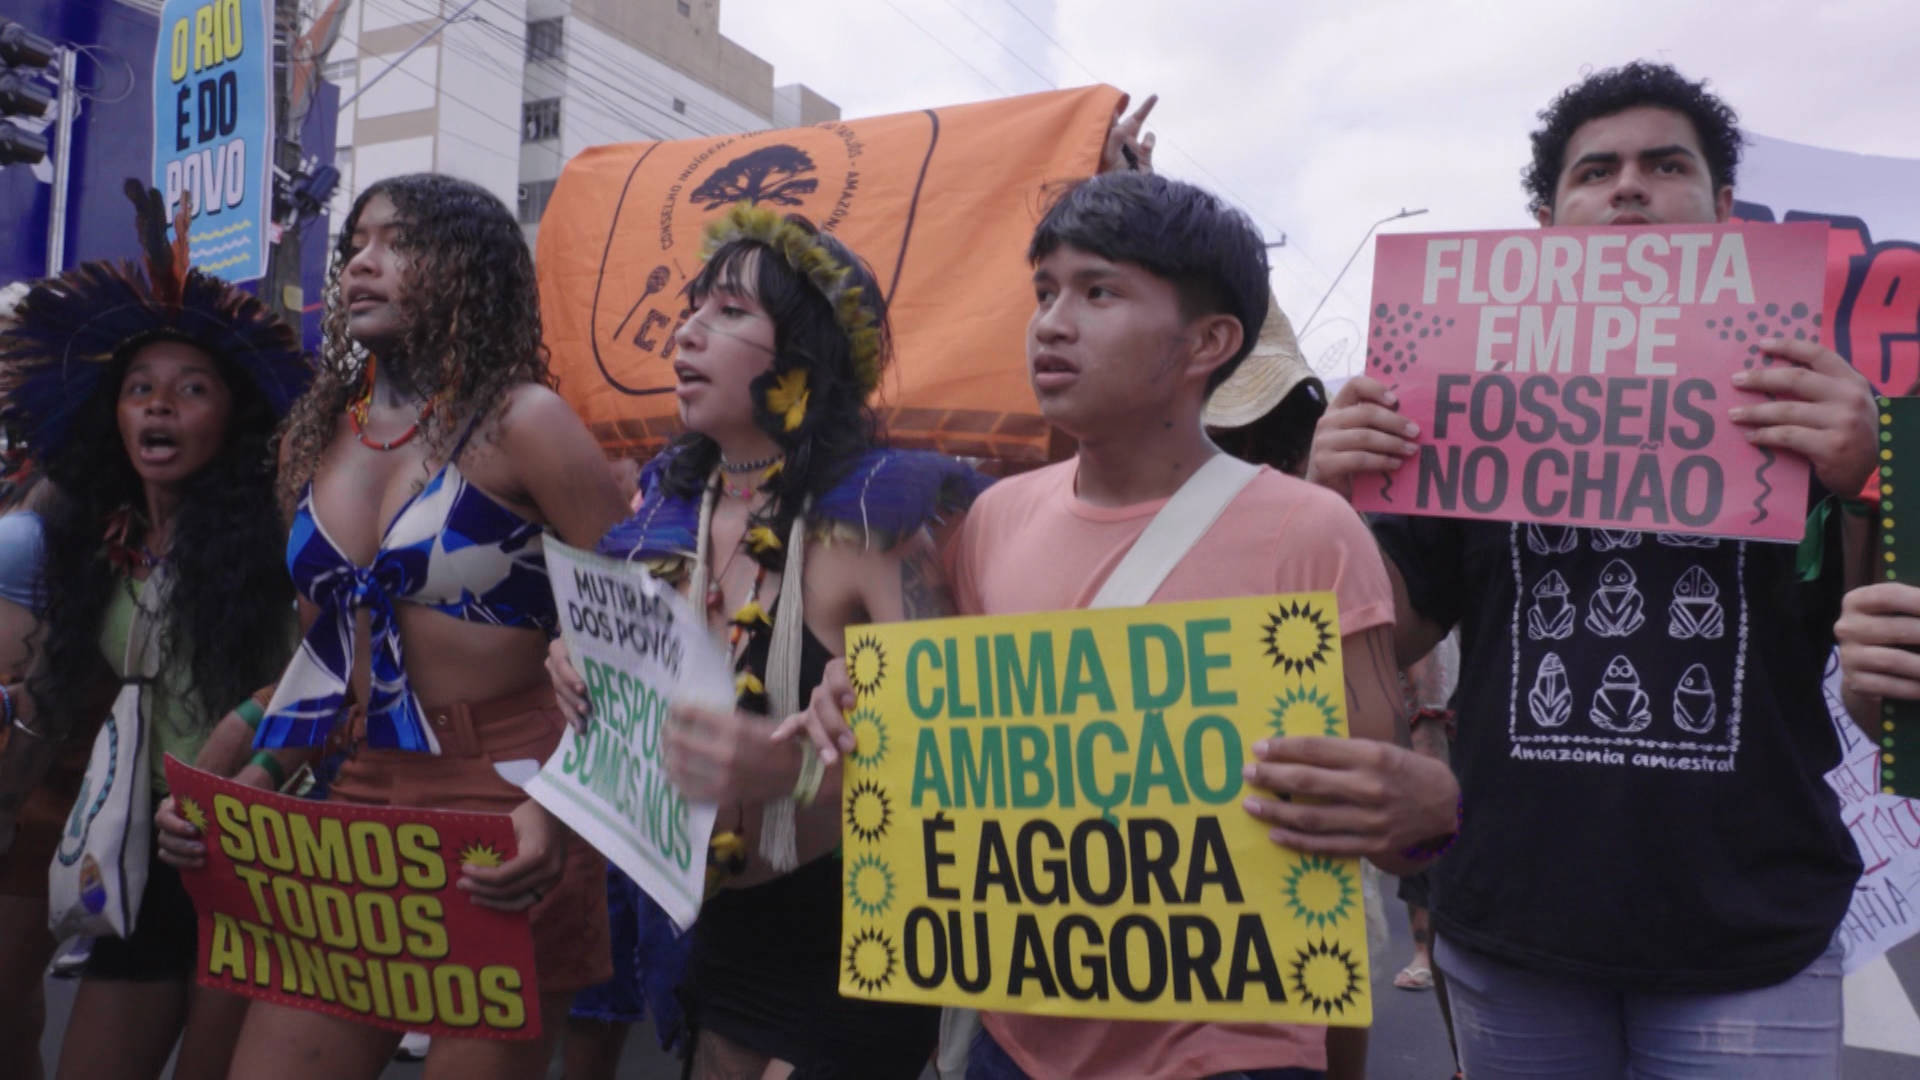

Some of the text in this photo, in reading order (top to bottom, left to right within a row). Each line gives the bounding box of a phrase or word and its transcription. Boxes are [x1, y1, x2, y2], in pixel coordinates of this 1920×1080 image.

[171, 0, 243, 84] O RIO
[176, 70, 238, 151] É DO
[165, 138, 245, 228] POVO
[660, 184, 682, 250] CONSELHO
[823, 170, 860, 232] AMAZÔNI
[1422, 232, 1755, 305] FLORESTA
[1475, 294, 1679, 375] EM PÉ
[1432, 362, 1717, 450] FÓSSEIS
[1415, 442, 1724, 528] NO CHÃO
[568, 600, 613, 643] DOS
[906, 617, 1237, 720] CLIMA DE
[562, 719, 641, 824] SOMOS
[911, 711, 1244, 828] AMBIÇÃO
[1632, 753, 1736, 772] ancestral
[213, 793, 448, 892] SOMOS
[923, 811, 1244, 905] É AGORA
[234, 865, 450, 961] TODOS
[903, 907, 1288, 1004] OU AGORA
[208, 914, 526, 1029] ATINGIDOS
